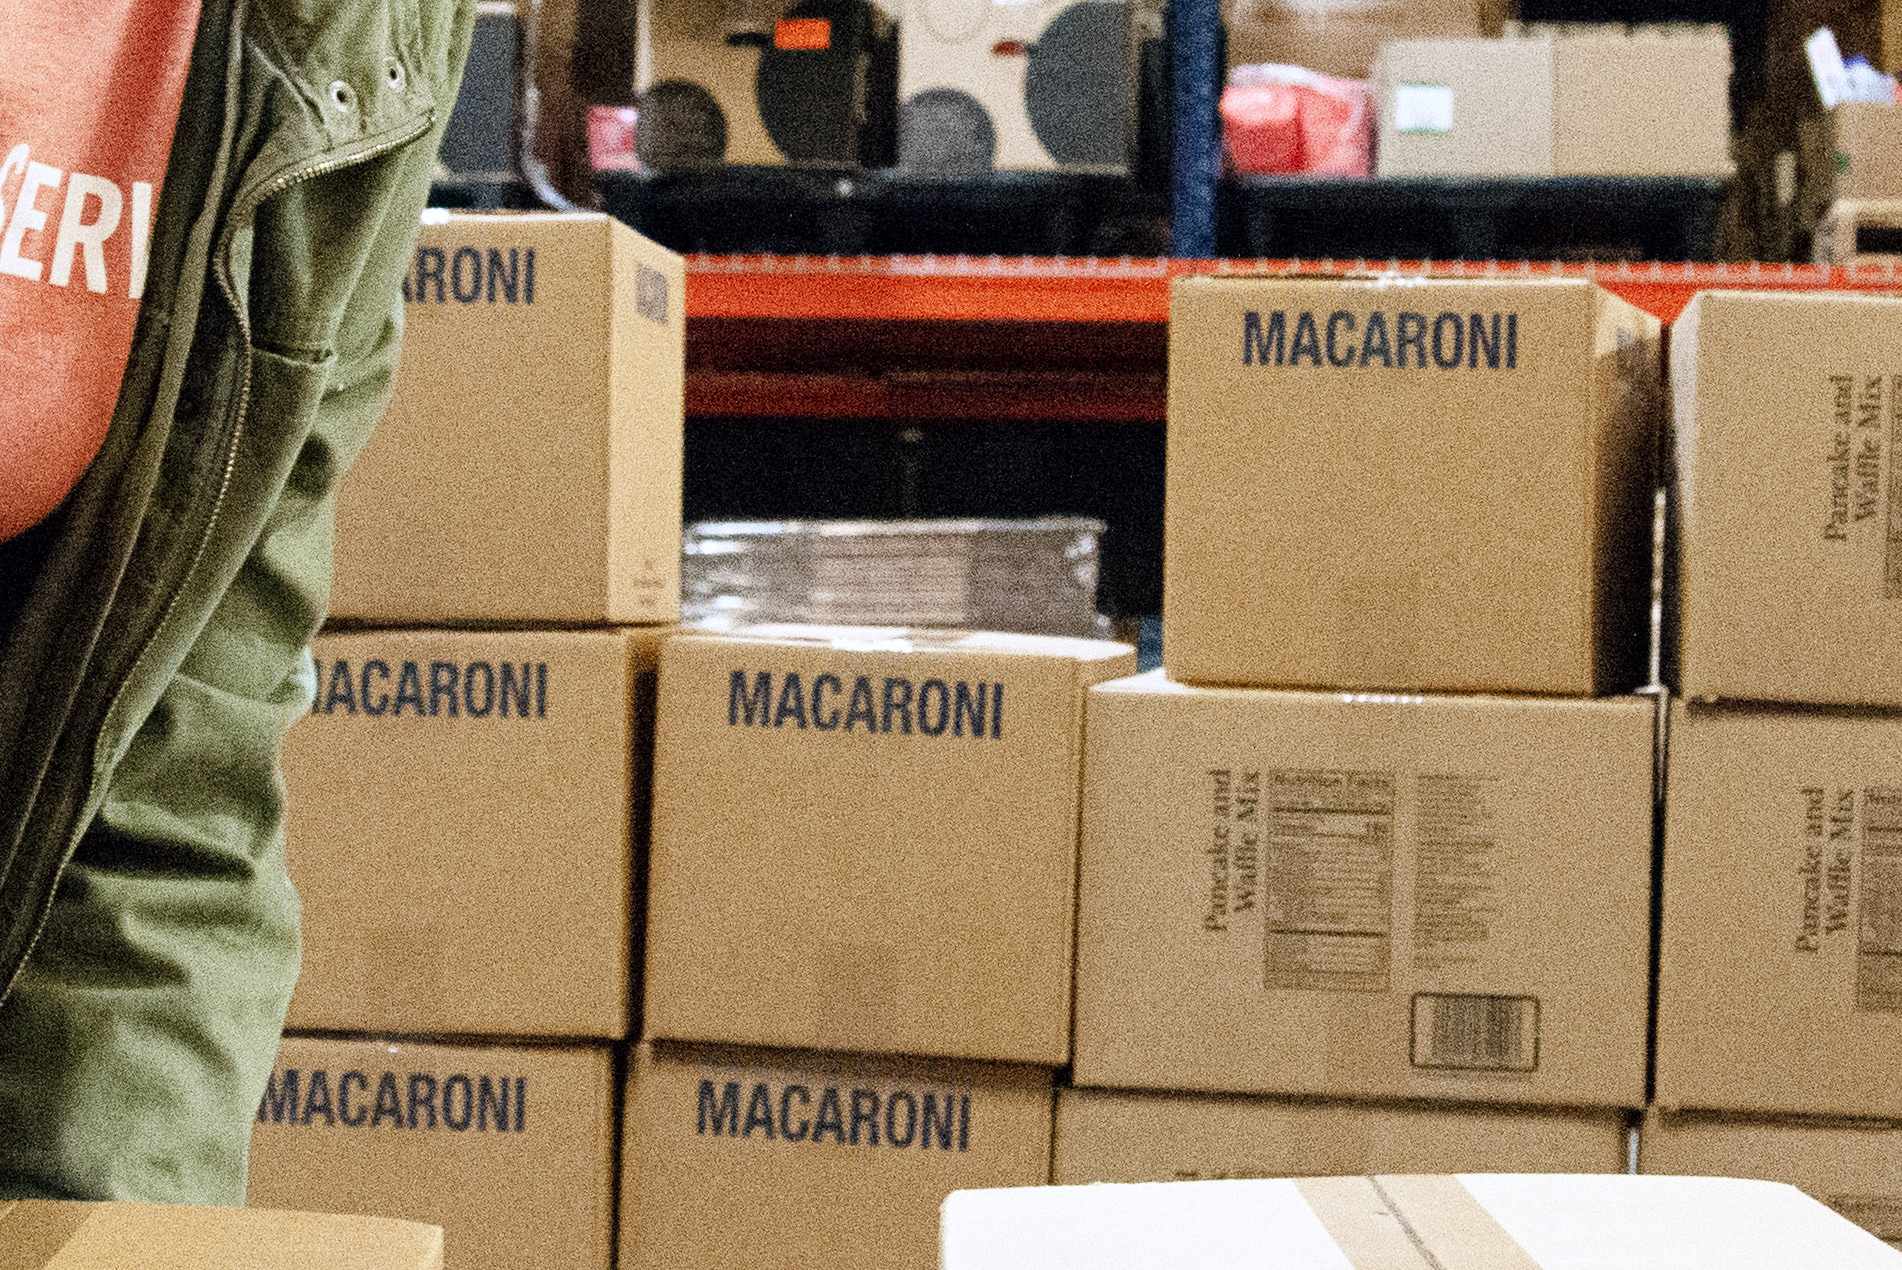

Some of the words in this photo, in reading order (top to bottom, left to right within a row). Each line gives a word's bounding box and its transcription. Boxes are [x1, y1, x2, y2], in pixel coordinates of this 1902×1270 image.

[403, 246, 535, 305] RONI
[1243, 310, 1518, 369] MACARONI
[1829, 376, 1854, 425] and
[1858, 376, 1883, 429] Mix
[1824, 432, 1851, 541] Pancake
[1855, 438, 1881, 522] Waffle
[312, 659, 547, 718] ACARONI
[728, 670, 1004, 740] MACARONI
[1206, 769, 1230, 818] and
[1235, 770, 1260, 823] Mix
[1799, 787, 1825, 837] and
[1828, 789, 1854, 841] Mix
[1202, 826, 1229, 933] Pancake
[1232, 831, 1258, 913] Waffle
[1795, 846, 1823, 954] Pancake
[1825, 849, 1852, 936] Waffle
[257, 1069, 526, 1132] MACARONI
[696, 1079, 973, 1152] MACARONI
